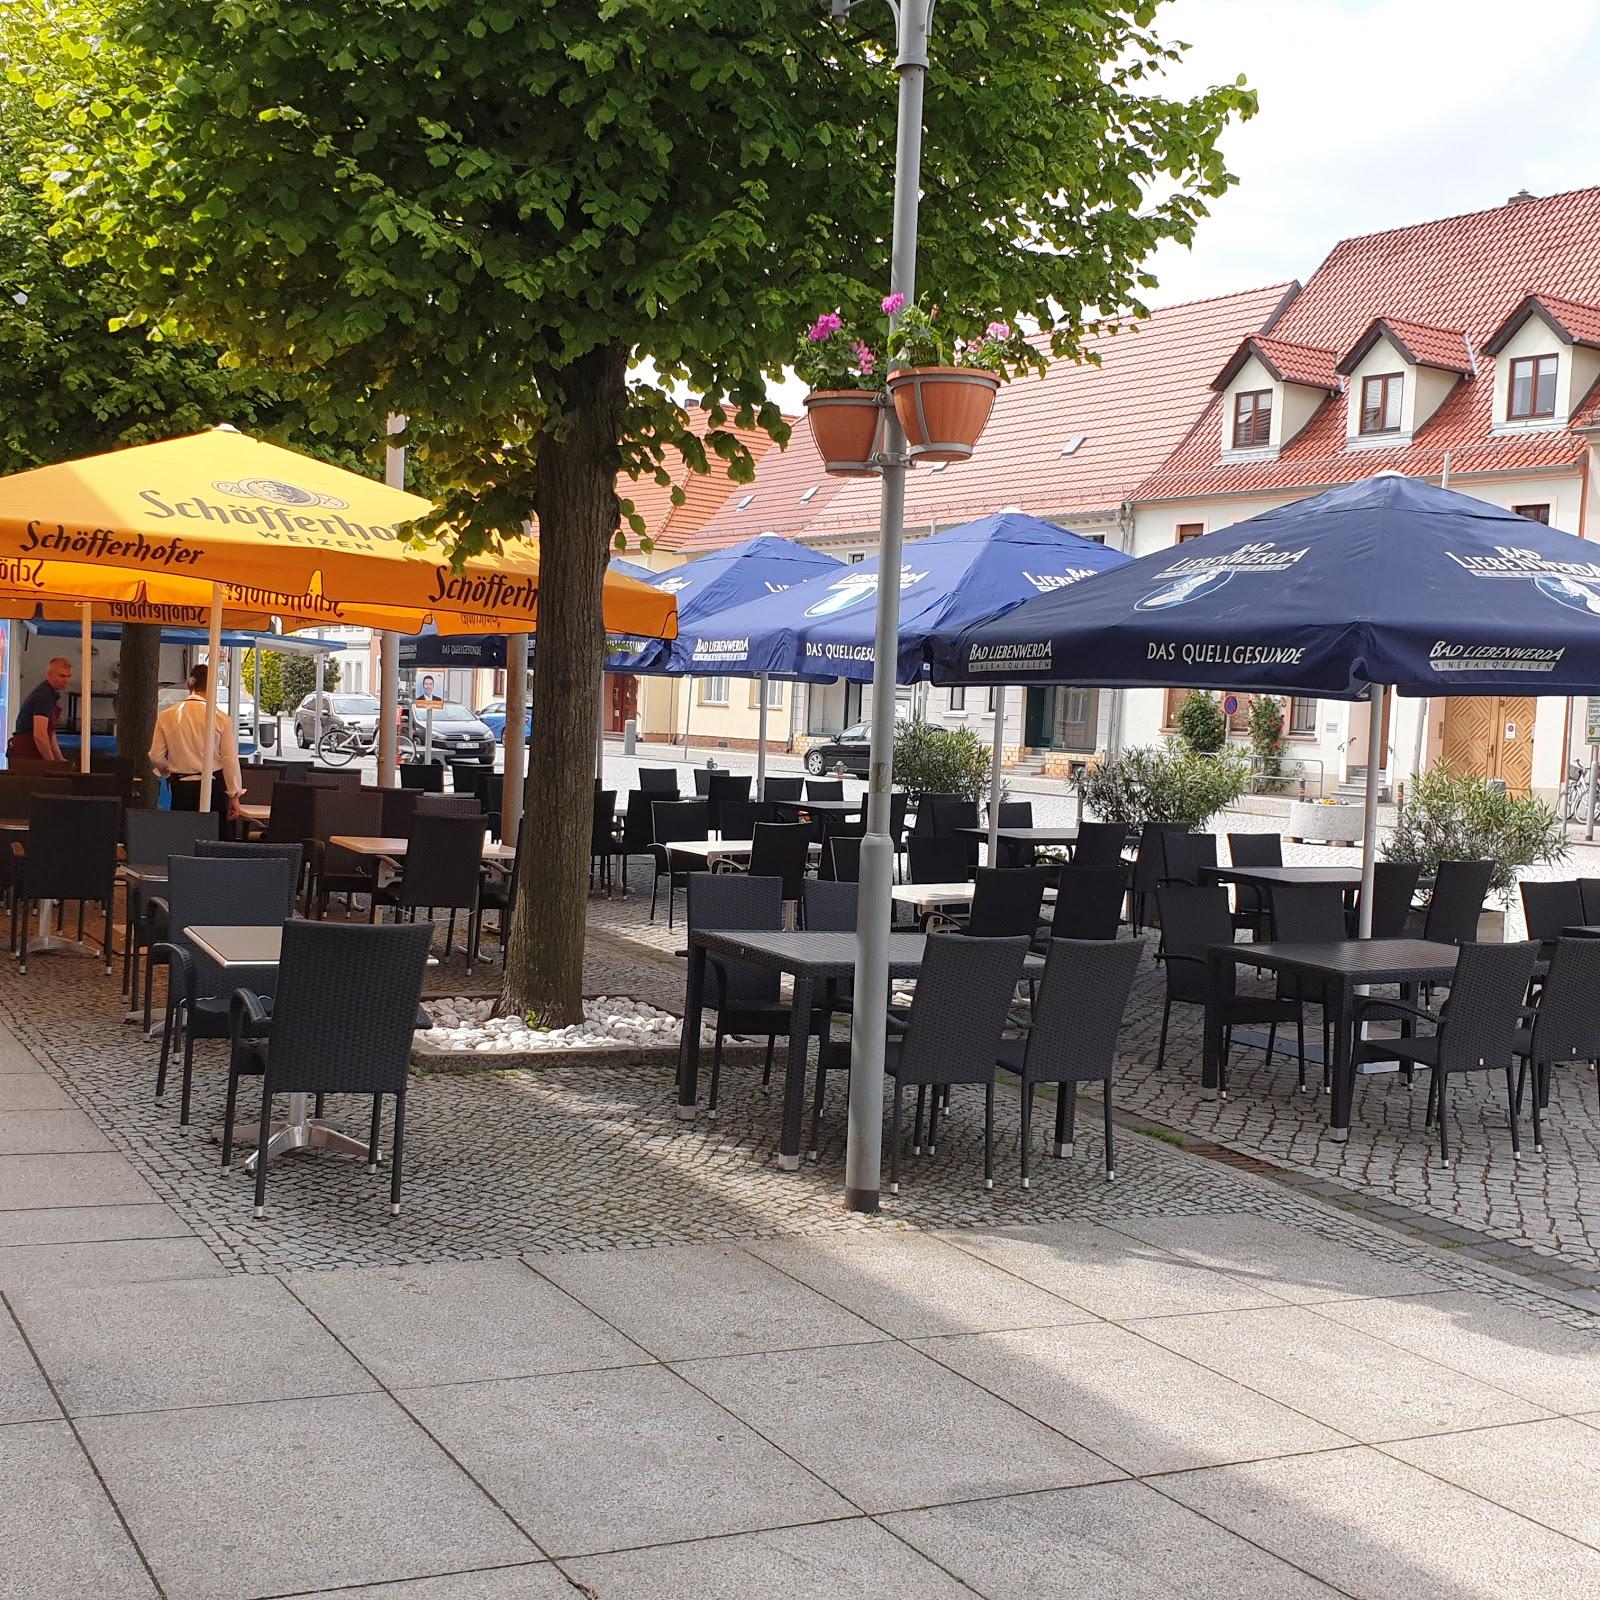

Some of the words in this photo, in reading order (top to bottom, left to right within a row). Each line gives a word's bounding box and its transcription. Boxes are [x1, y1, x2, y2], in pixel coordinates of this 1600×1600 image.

[138, 489, 449, 550] Schöfferho
[19, 520, 205, 566] Schöfferhofer
[257, 530, 375, 551] WEIZEN
[1164, 547, 1311, 572] LIEBENWERDA
[1494, 546, 1541, 560] BAD
[428, 565, 540, 612] Schöfferh
[694, 638, 709, 653] BAD
[708, 636, 749, 653] LIEBENWERDA
[806, 642, 822, 657] DAS
[825, 643, 876, 662] QUELLGESU
[969, 643, 989, 661] BAD
[988, 639, 1052, 660] LIEBENWERDA
[1147, 642, 1176, 661] DAS
[1182, 643, 1306, 665] QUELLGESUNDE
[1429, 640, 1464, 658] BAD
[1462, 646, 1566, 661] LIEBENWERDA
[1432, 660, 1553, 670] MINERALQUELLEN
